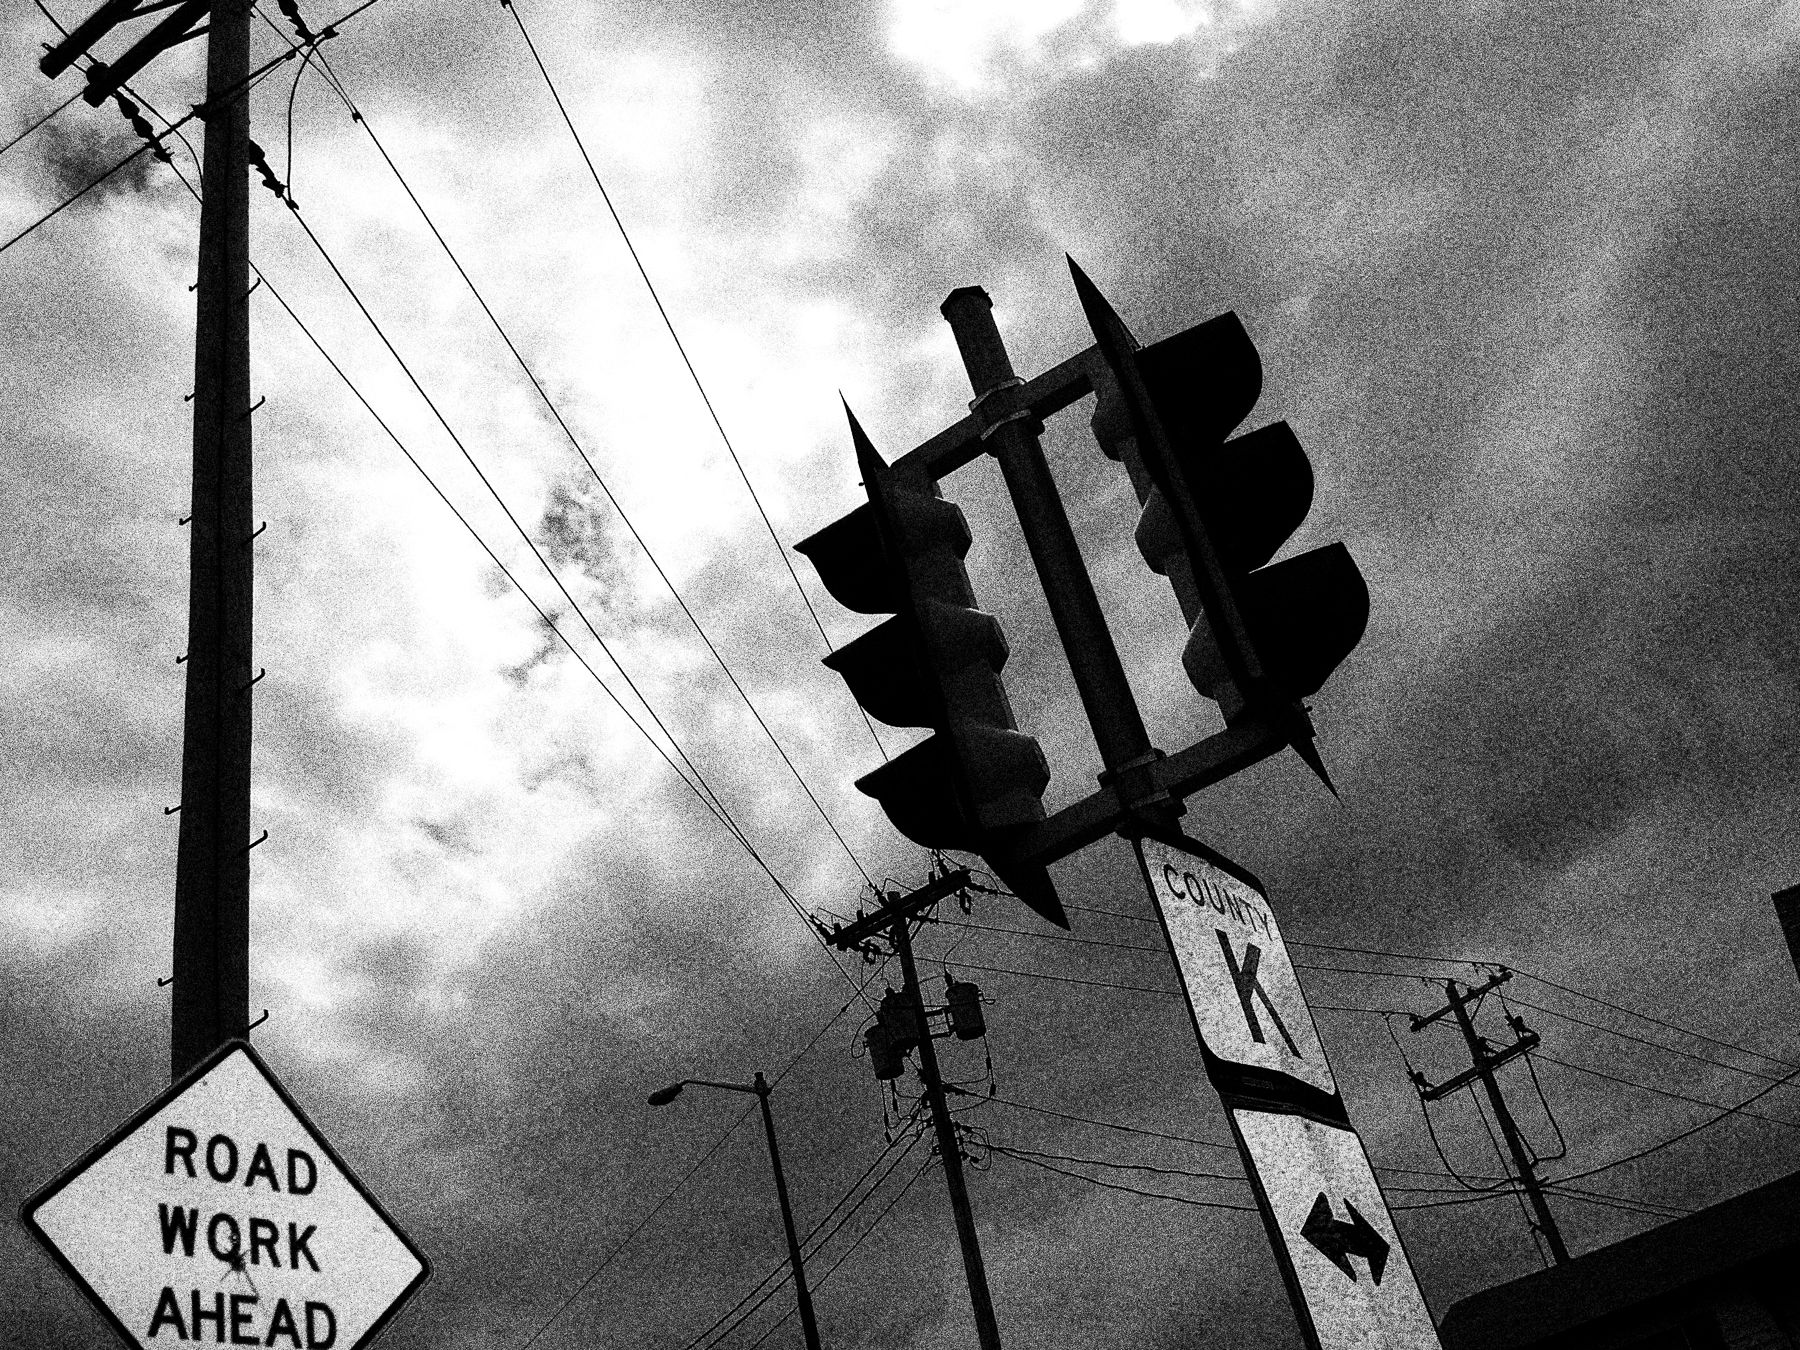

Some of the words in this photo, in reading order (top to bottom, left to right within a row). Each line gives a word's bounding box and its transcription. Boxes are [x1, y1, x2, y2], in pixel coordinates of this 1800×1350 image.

[1163, 863, 1273, 941] COUNTY
[1215, 928, 1303, 1059] K
[165, 1126, 318, 1196] ROAD
[158, 1203, 320, 1272] WORK
[147, 1286, 337, 1350] AHEAD
